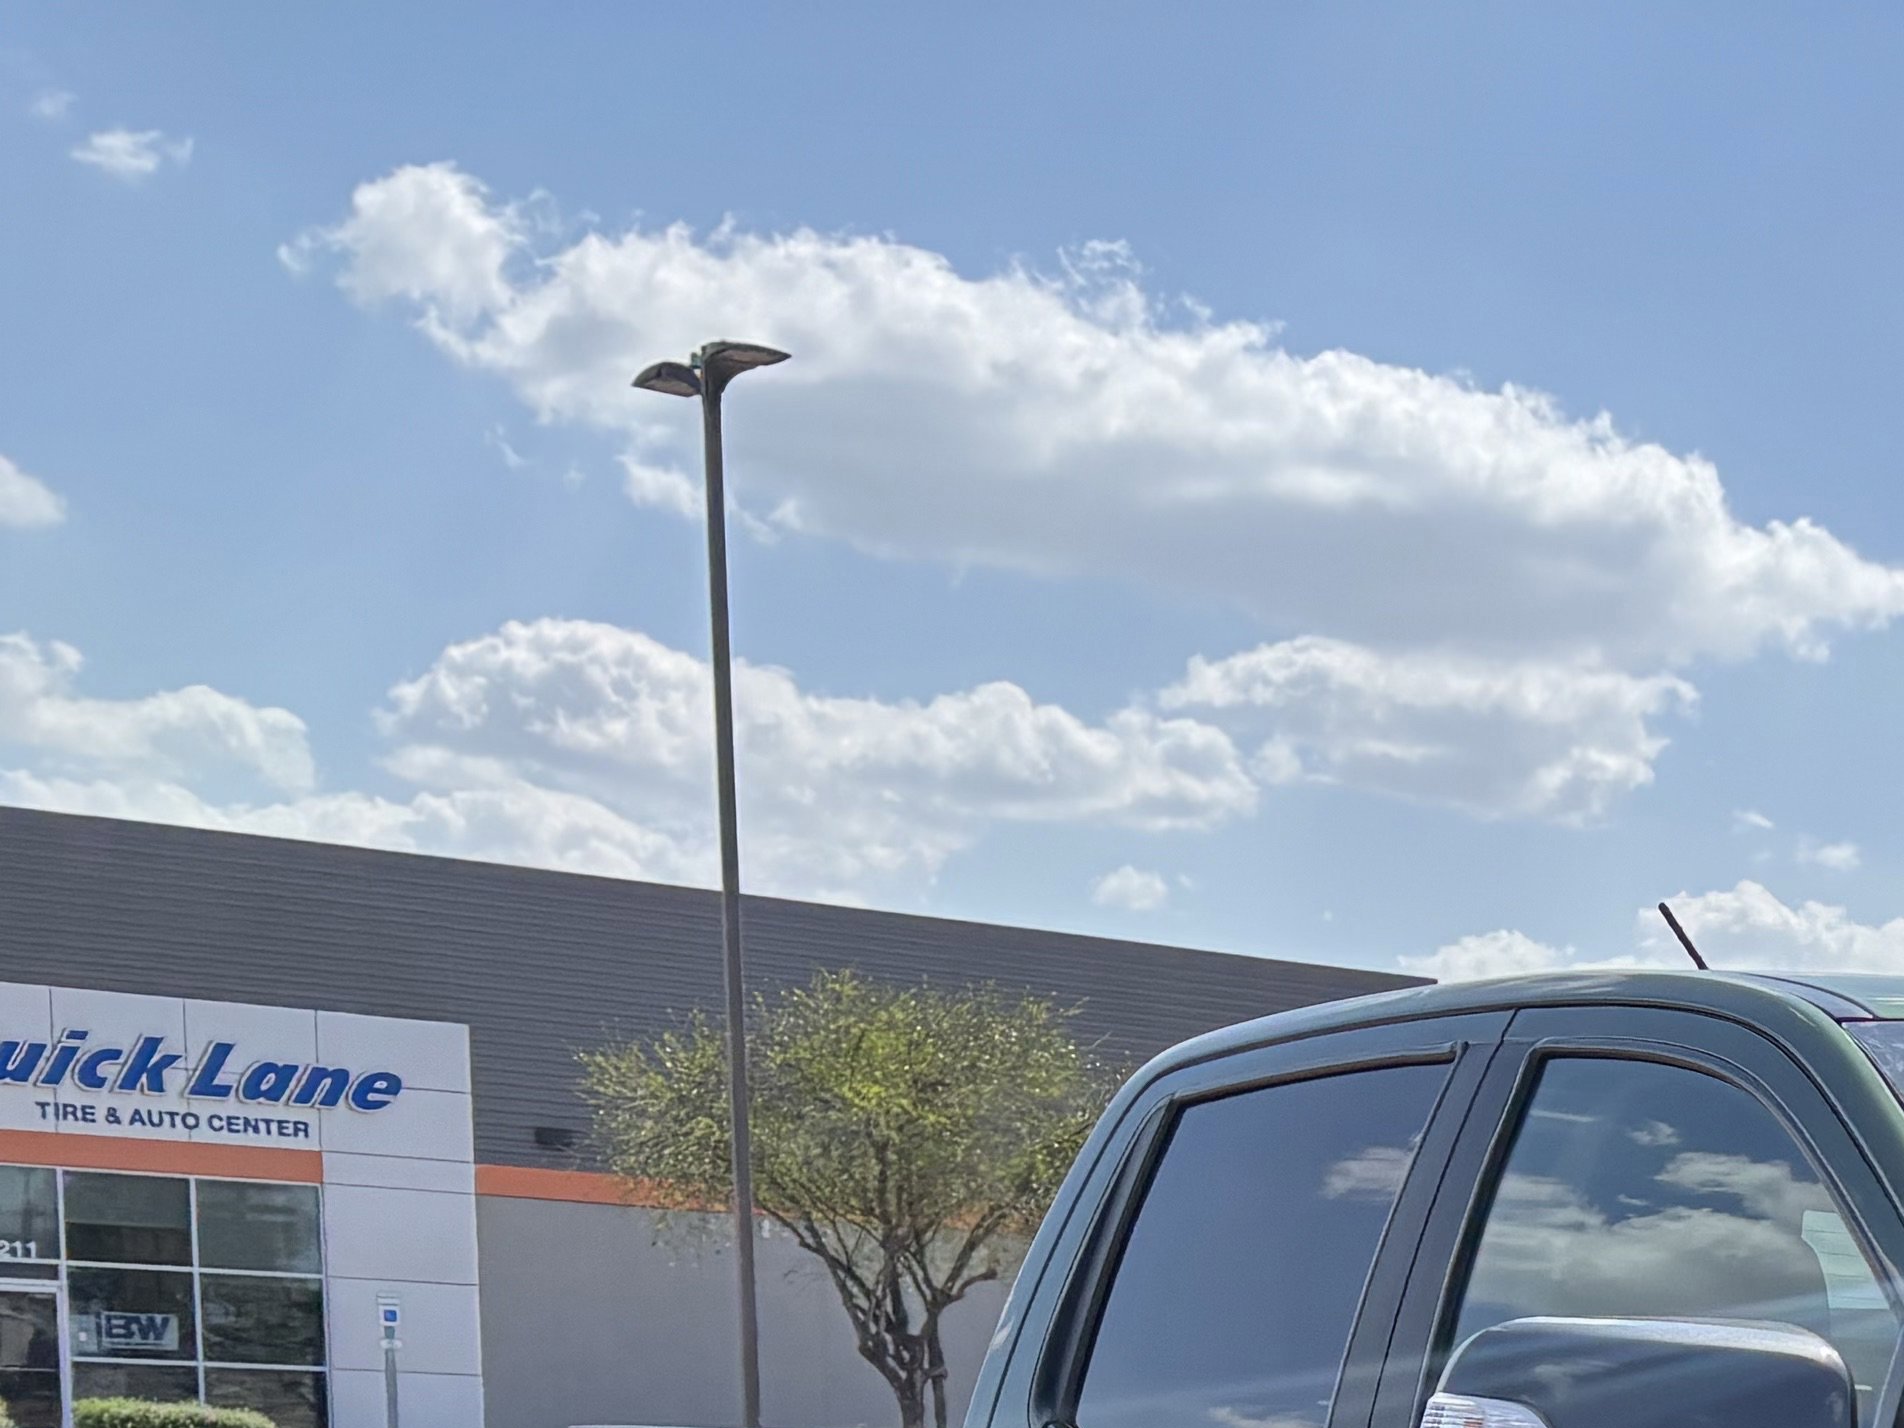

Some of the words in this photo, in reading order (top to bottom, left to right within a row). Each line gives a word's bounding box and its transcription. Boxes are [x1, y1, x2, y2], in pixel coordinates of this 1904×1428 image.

[0, 1029, 182, 1093] uick
[187, 1042, 402, 1111] Lane
[35, 1101, 97, 1124] TIRE
[105, 1106, 121, 1126] &
[129, 1109, 200, 1131] AUTO
[207, 1114, 311, 1139] CENTER
